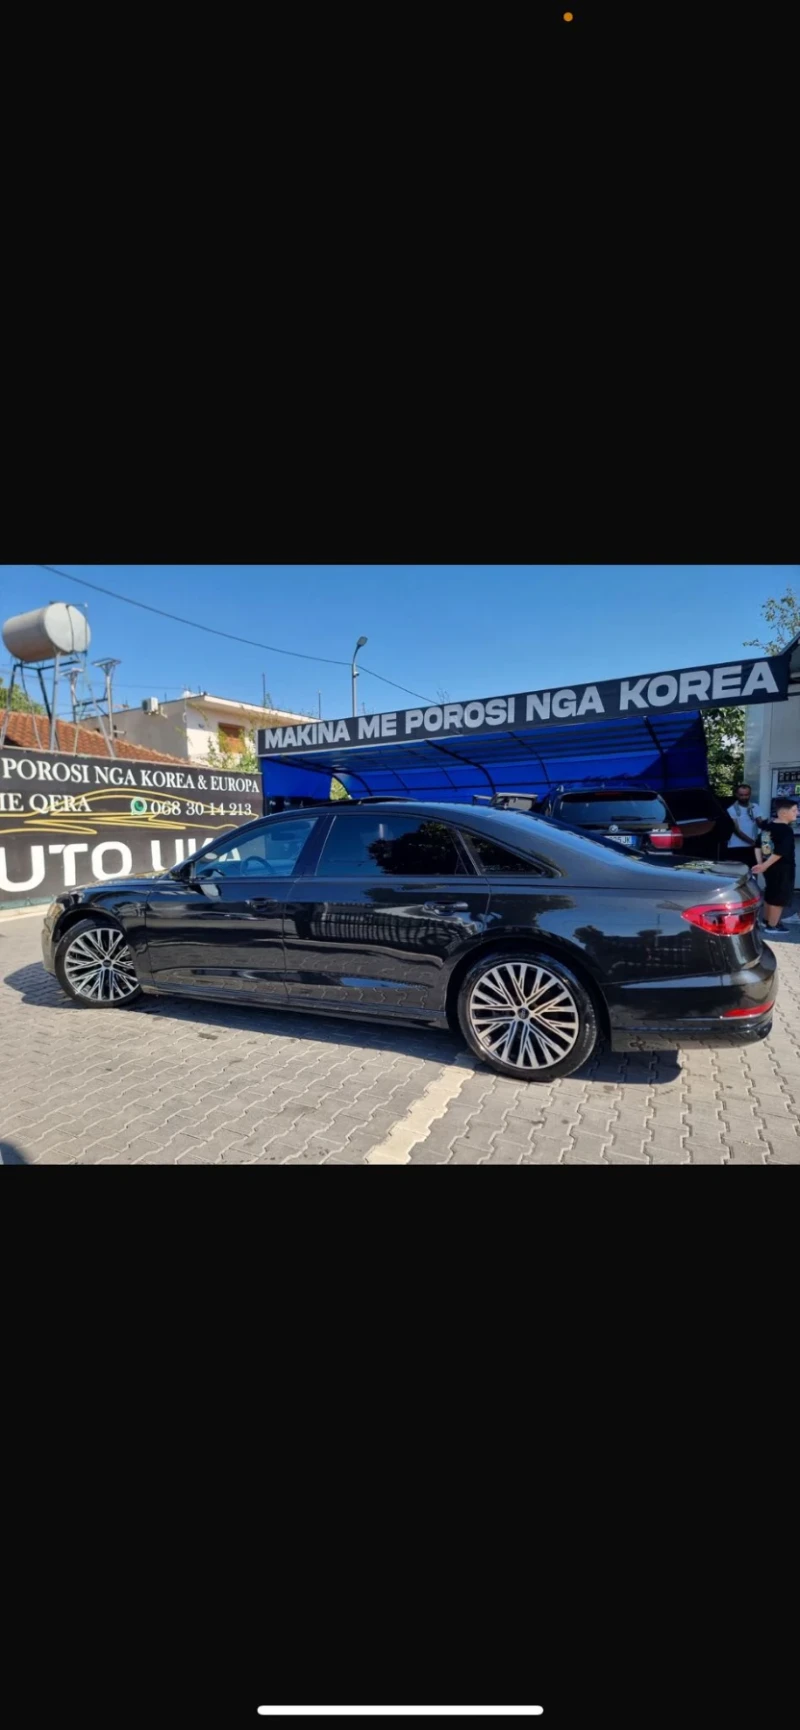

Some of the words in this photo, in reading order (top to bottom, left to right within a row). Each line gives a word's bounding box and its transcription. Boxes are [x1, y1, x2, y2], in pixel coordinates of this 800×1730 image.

[264, 720, 350, 749] MAKINA
[358, 712, 397, 740] ME
[405, 697, 515, 734] POROSI
[525, 685, 605, 722] NGA
[619, 661, 780, 711] KOREA
[1, 757, 90, 784] POROSI
[94, 765, 136, 787] NGA
[141, 769, 195, 790] KOREA
[197, 776, 208, 791] &
[210, 775, 260, 793] EUROPA
[29, 793, 92, 814] QERA
[150, 800, 182, 816] 068
[185, 801, 205, 816] 30
[209, 802, 226, 817] 14
[228, 802, 252, 817] 213
